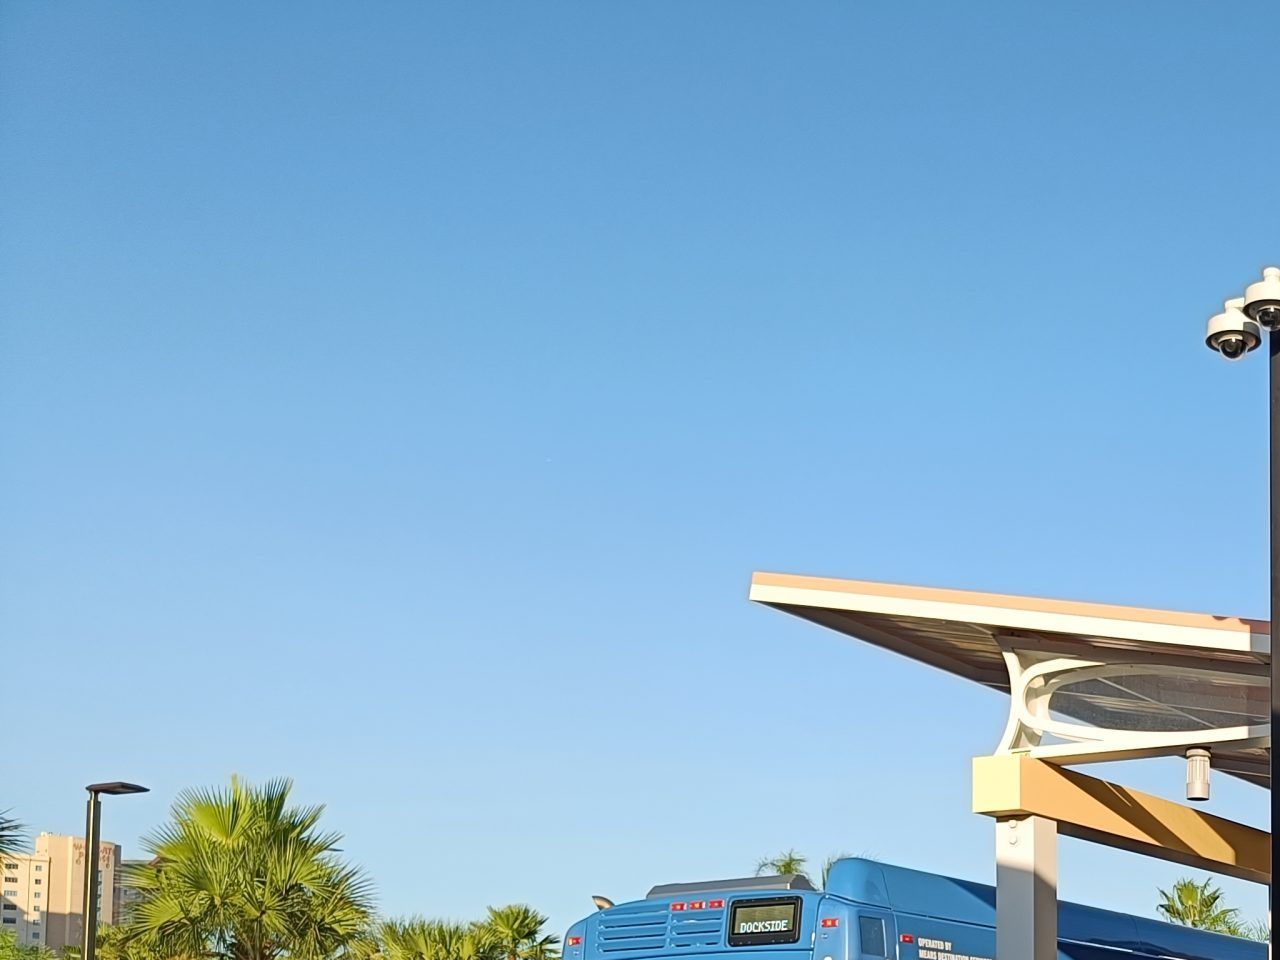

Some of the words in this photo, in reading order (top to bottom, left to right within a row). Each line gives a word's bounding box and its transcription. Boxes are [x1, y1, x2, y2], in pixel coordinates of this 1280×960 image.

[740, 920, 788, 933] DOCKSIDE
[918, 937, 944, 950] OPERATED
[945, 941, 952, 951] BY
[919, 949, 937, 960] MEARS
